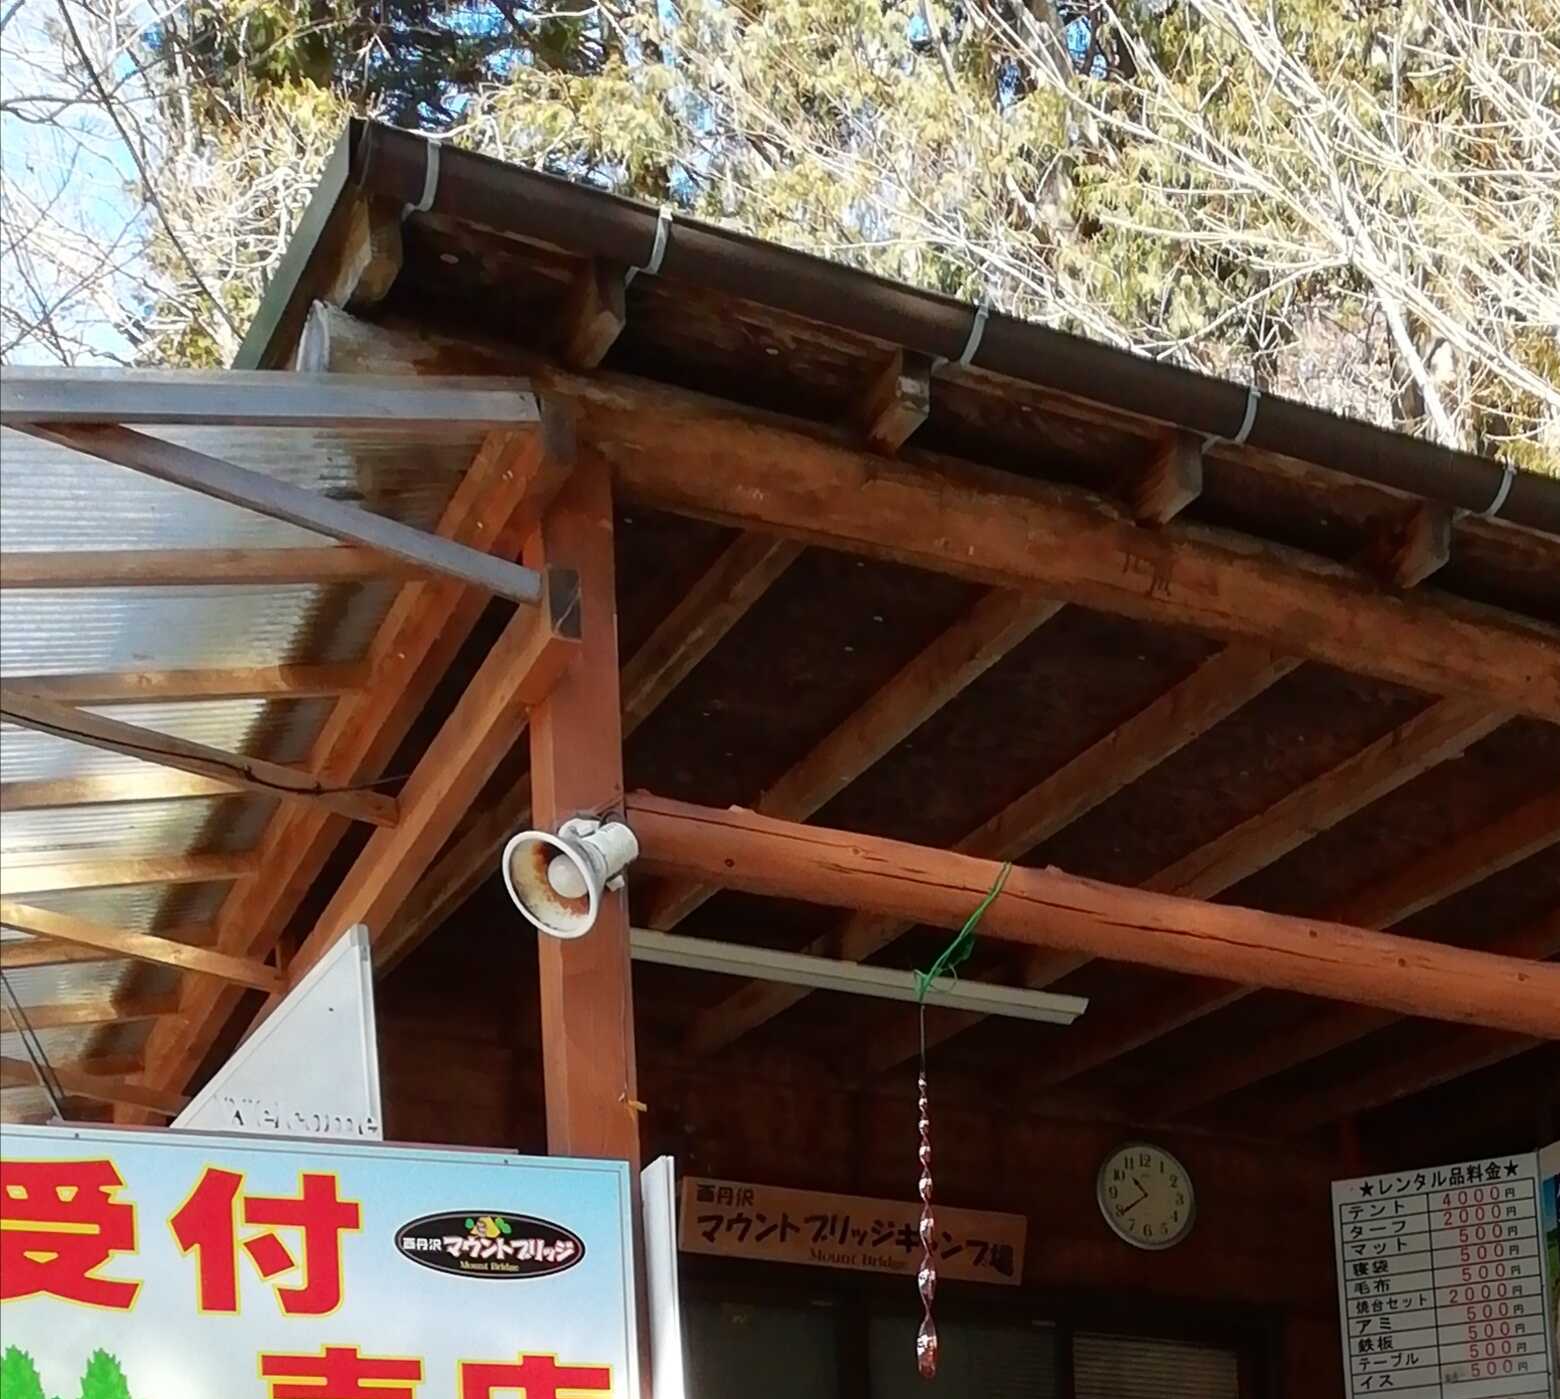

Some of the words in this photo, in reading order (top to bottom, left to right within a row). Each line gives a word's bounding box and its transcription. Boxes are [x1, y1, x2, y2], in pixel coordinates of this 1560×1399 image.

[1124, 1156, 1134, 1170] 11
[1140, 1154, 1151, 1168] 12
[1169, 1175, 1178, 1188] 2
[1378, 1161, 1502, 1194] レンタル品料金
[696, 1184, 755, 1207] 西丹沢
[1349, 1200, 1406, 1221] テント
[1128, 1218, 1136, 1231] 7
[1143, 1223, 1152, 1237] 6
[0, 1159, 362, 1317] 受付
[1351, 1237, 1408, 1256] マット
[442, 1235, 575, 1262] マウントブリッジ
[460, 1261, 489, 1271] Mount
[1353, 1259, 1389, 1277] 寝袋
[1354, 1278, 1391, 1294] 毛布
[1355, 1293, 1428, 1314] 焼台セット
[1355, 1317, 1393, 1334] アミ
[1358, 1336, 1394, 1352] 鉄板
[1358, 1353, 1419, 1371] テーブル
[1360, 1374, 1394, 1390] イス
